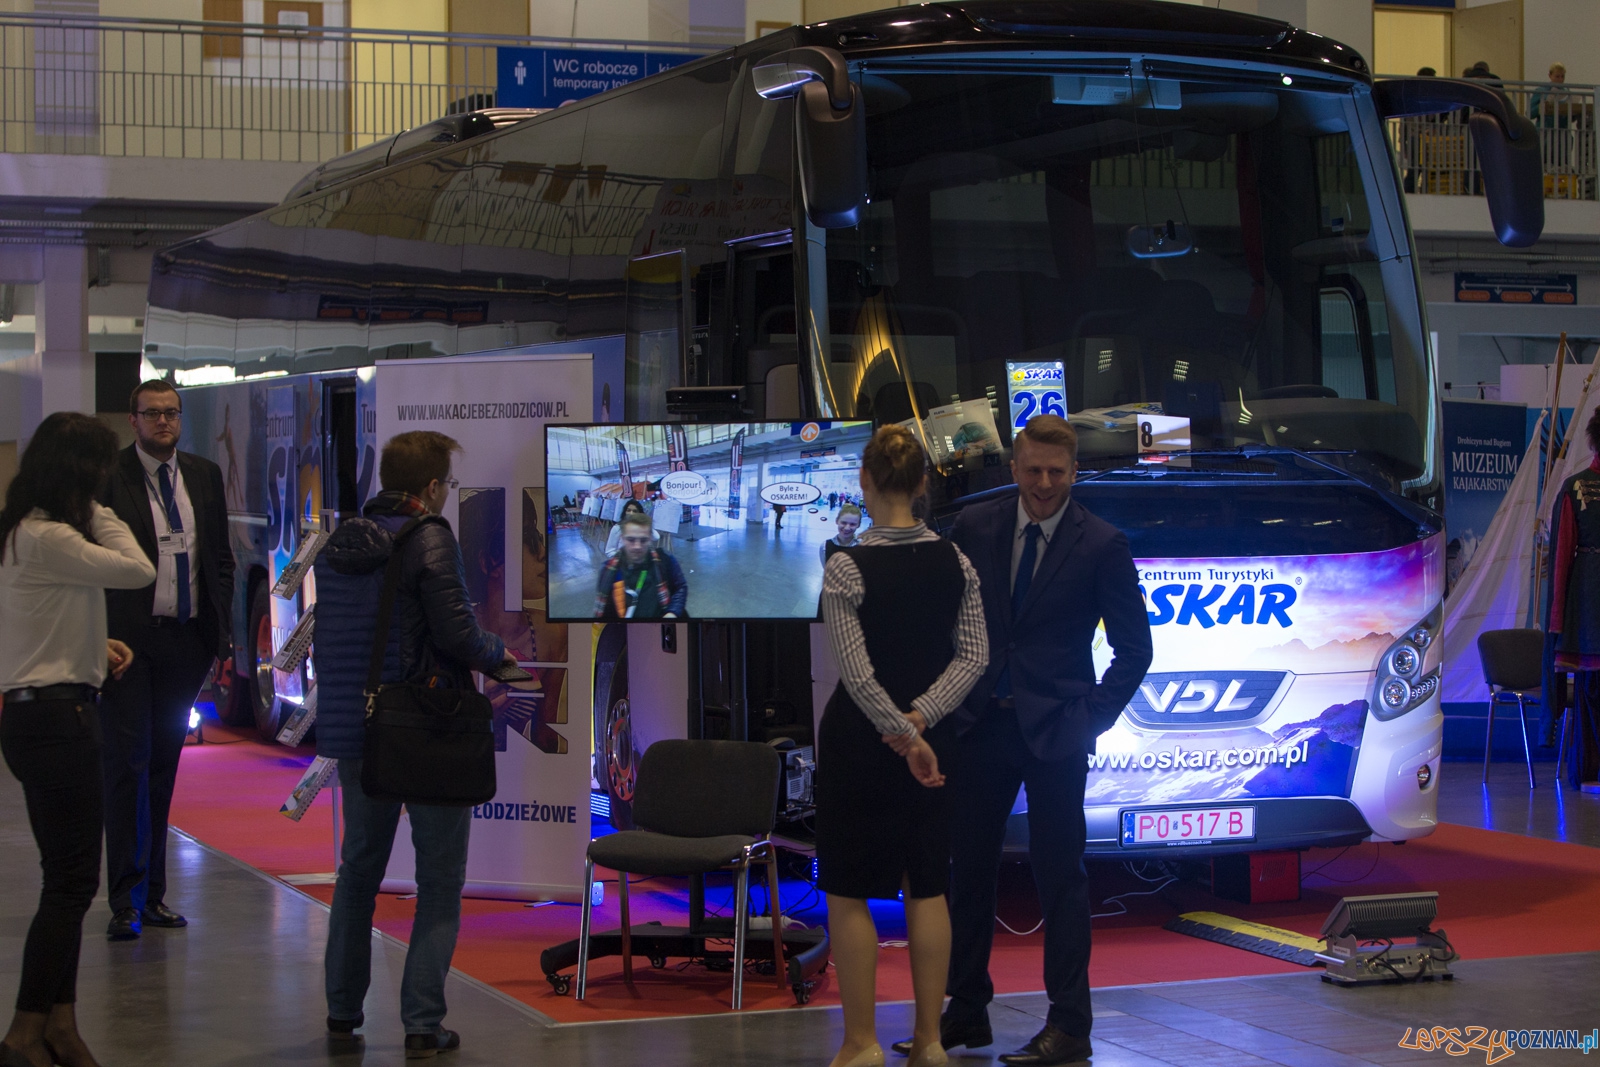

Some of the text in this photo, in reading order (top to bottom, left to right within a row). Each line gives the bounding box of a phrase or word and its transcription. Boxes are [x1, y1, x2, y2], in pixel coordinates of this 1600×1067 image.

[553, 59, 638, 75] WC robocze
[553, 77, 609, 91] temporary
[1013, 369, 1063, 382] OSKAR
[397, 401, 569, 421] WWW.WAKACJEBEZRODZICOW.PL
[1013, 391, 1065, 428] 26
[1141, 421, 1153, 447] 8
[1457, 436, 1512, 448] Drohiczyn nad Bugiem
[1452, 451, 1518, 474] MUZEUM
[666, 481, 702, 490] Bonjour!
[779, 485, 793, 493] Byle
[770, 493, 808, 501] OSKAREM!
[1137, 568, 1274, 583] Centrum Turystyki
[1138, 583, 1297, 629] SKAR
[1140, 679, 1258, 713] VDL
[472, 800, 577, 823] ŁODZIEŻOWE
[1181, 812, 1221, 836] 517
[1228, 811, 1244, 835] B
